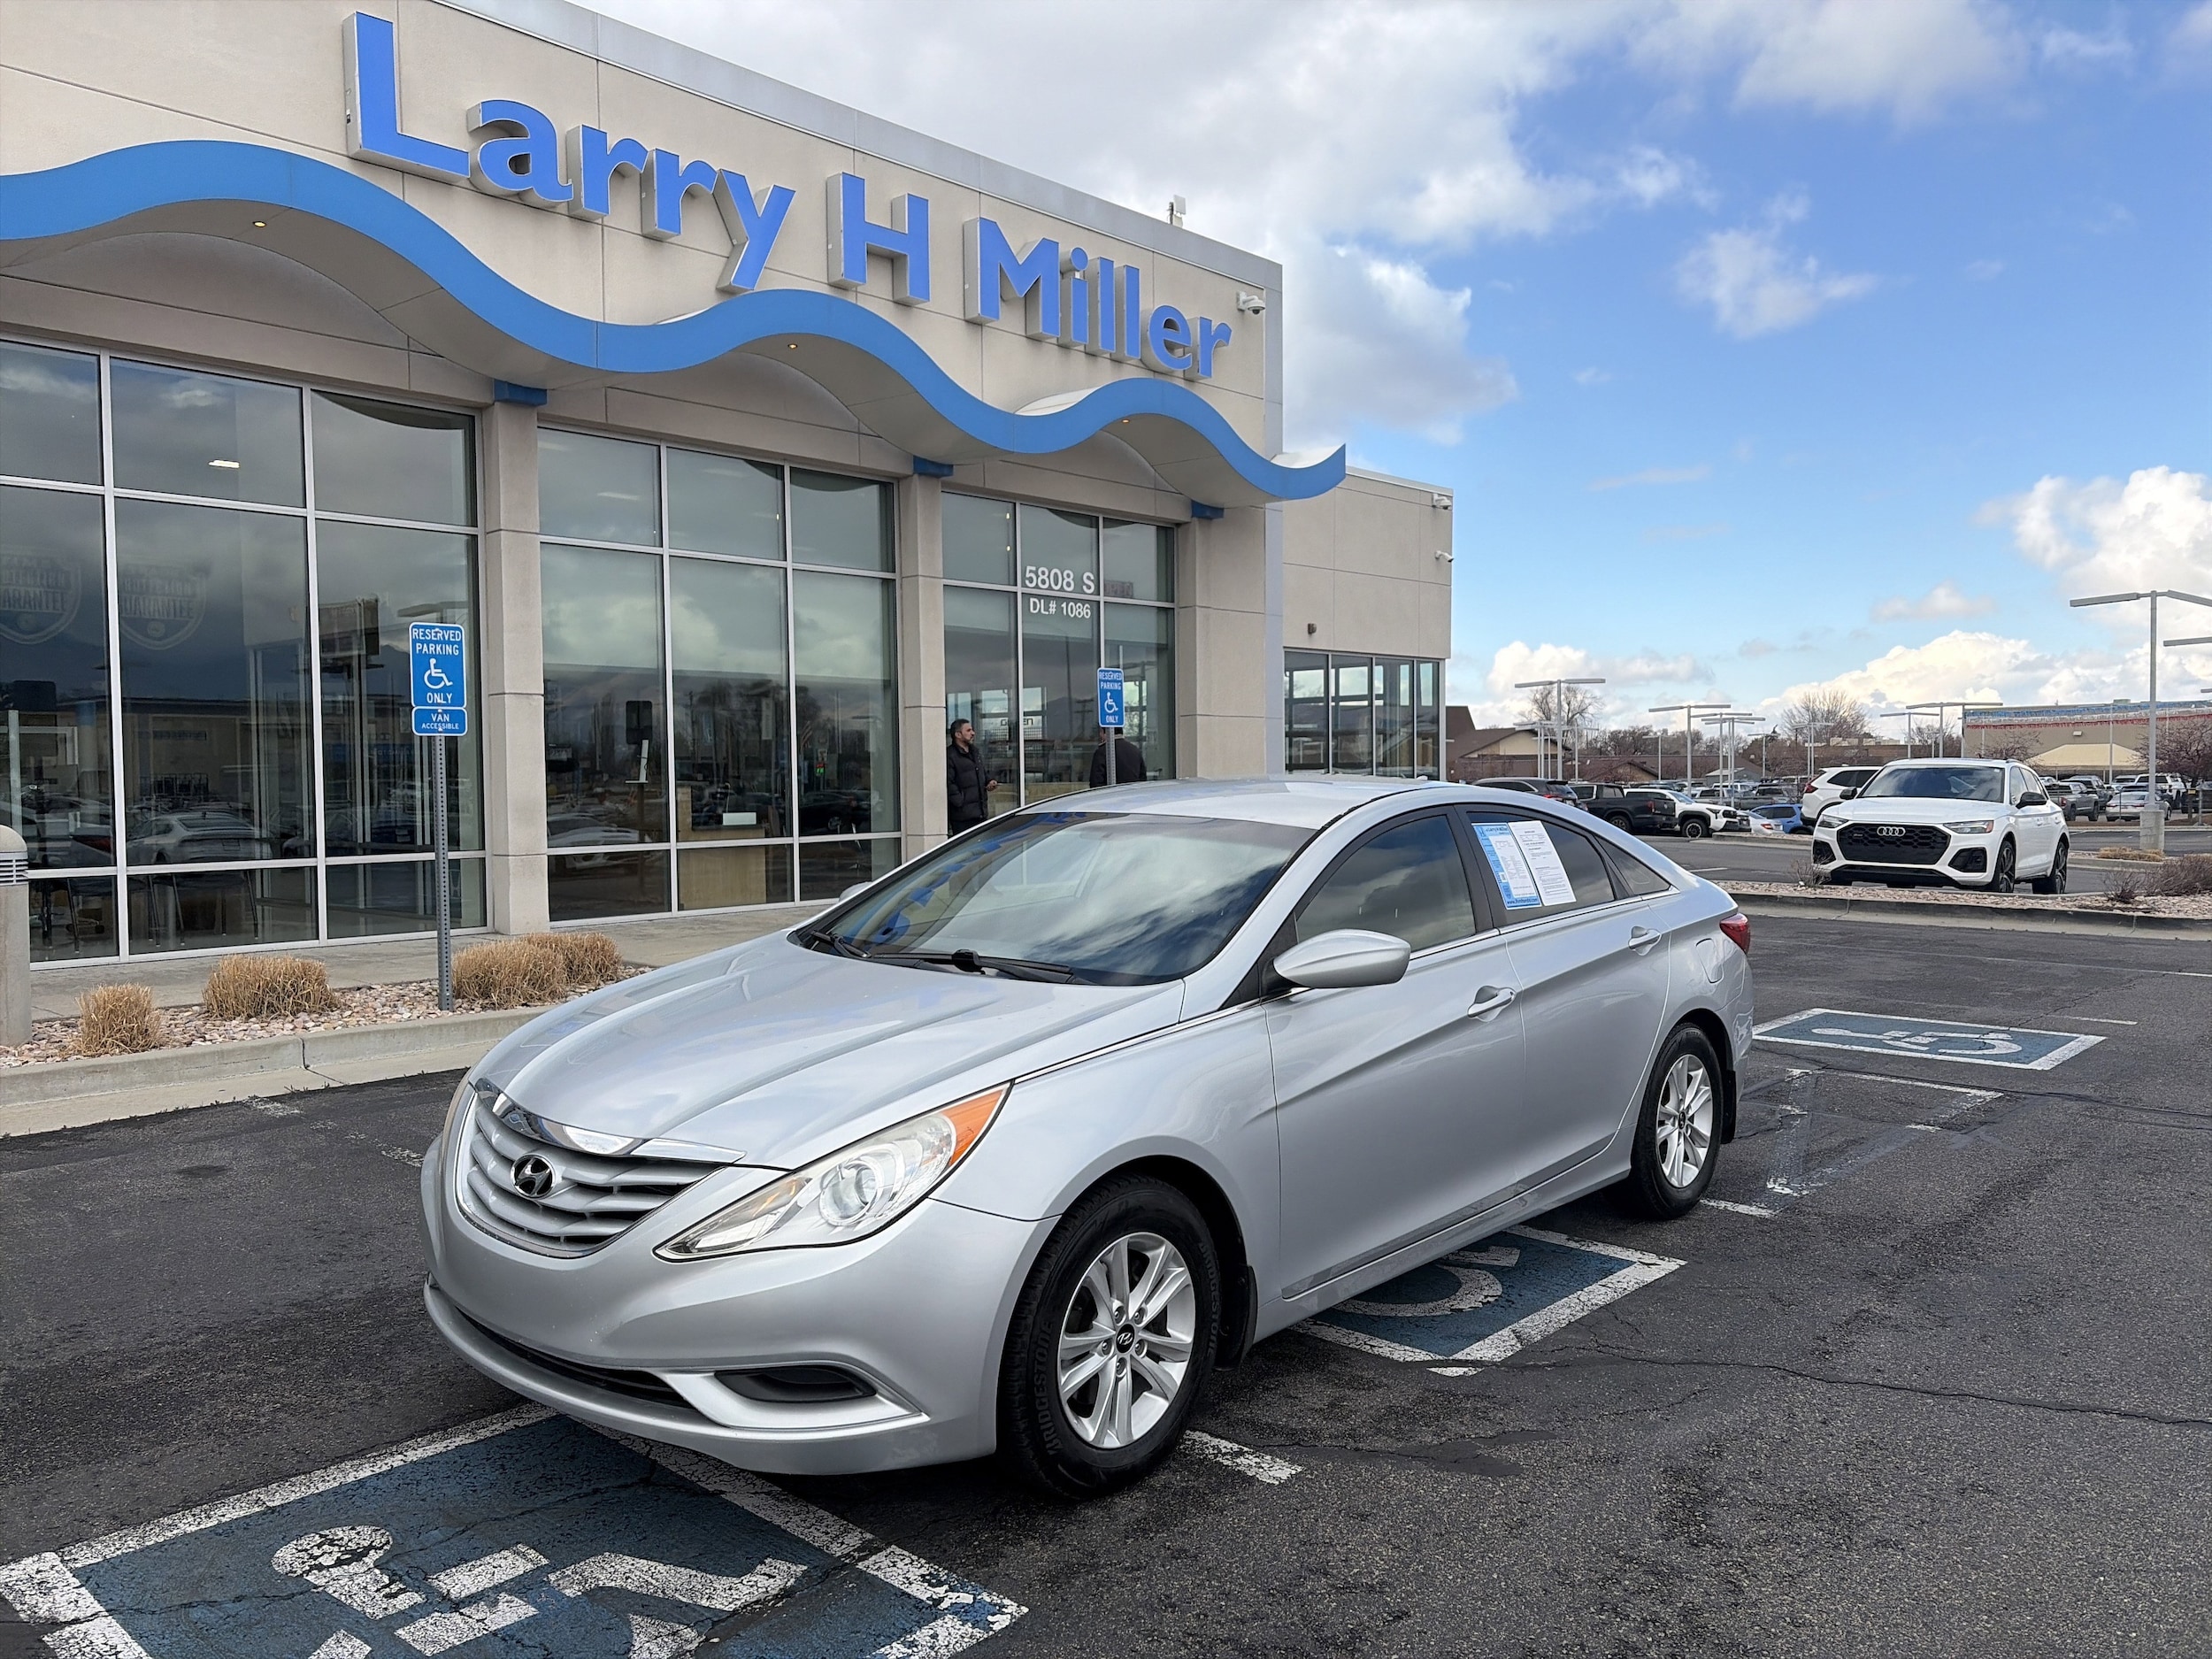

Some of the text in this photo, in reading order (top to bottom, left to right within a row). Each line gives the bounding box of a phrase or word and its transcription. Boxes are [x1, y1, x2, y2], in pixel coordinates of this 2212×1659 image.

[343, 11, 1232, 381] Larry H Miller
[1025, 565, 1095, 594] 5808 S
[1029, 597, 1092, 619] DL# 1086
[412, 627, 462, 641] RESERVED
[416, 643, 459, 656] PARKING
[1099, 671, 1123, 680] RESERVED
[1100, 681, 1122, 690] PARKING
[426, 693, 453, 704] ONLY
[431, 713, 450, 722] VAN
[1105, 714, 1119, 724] ONLY
[1033, 1321, 1063, 1457] BRIDGESTONE
